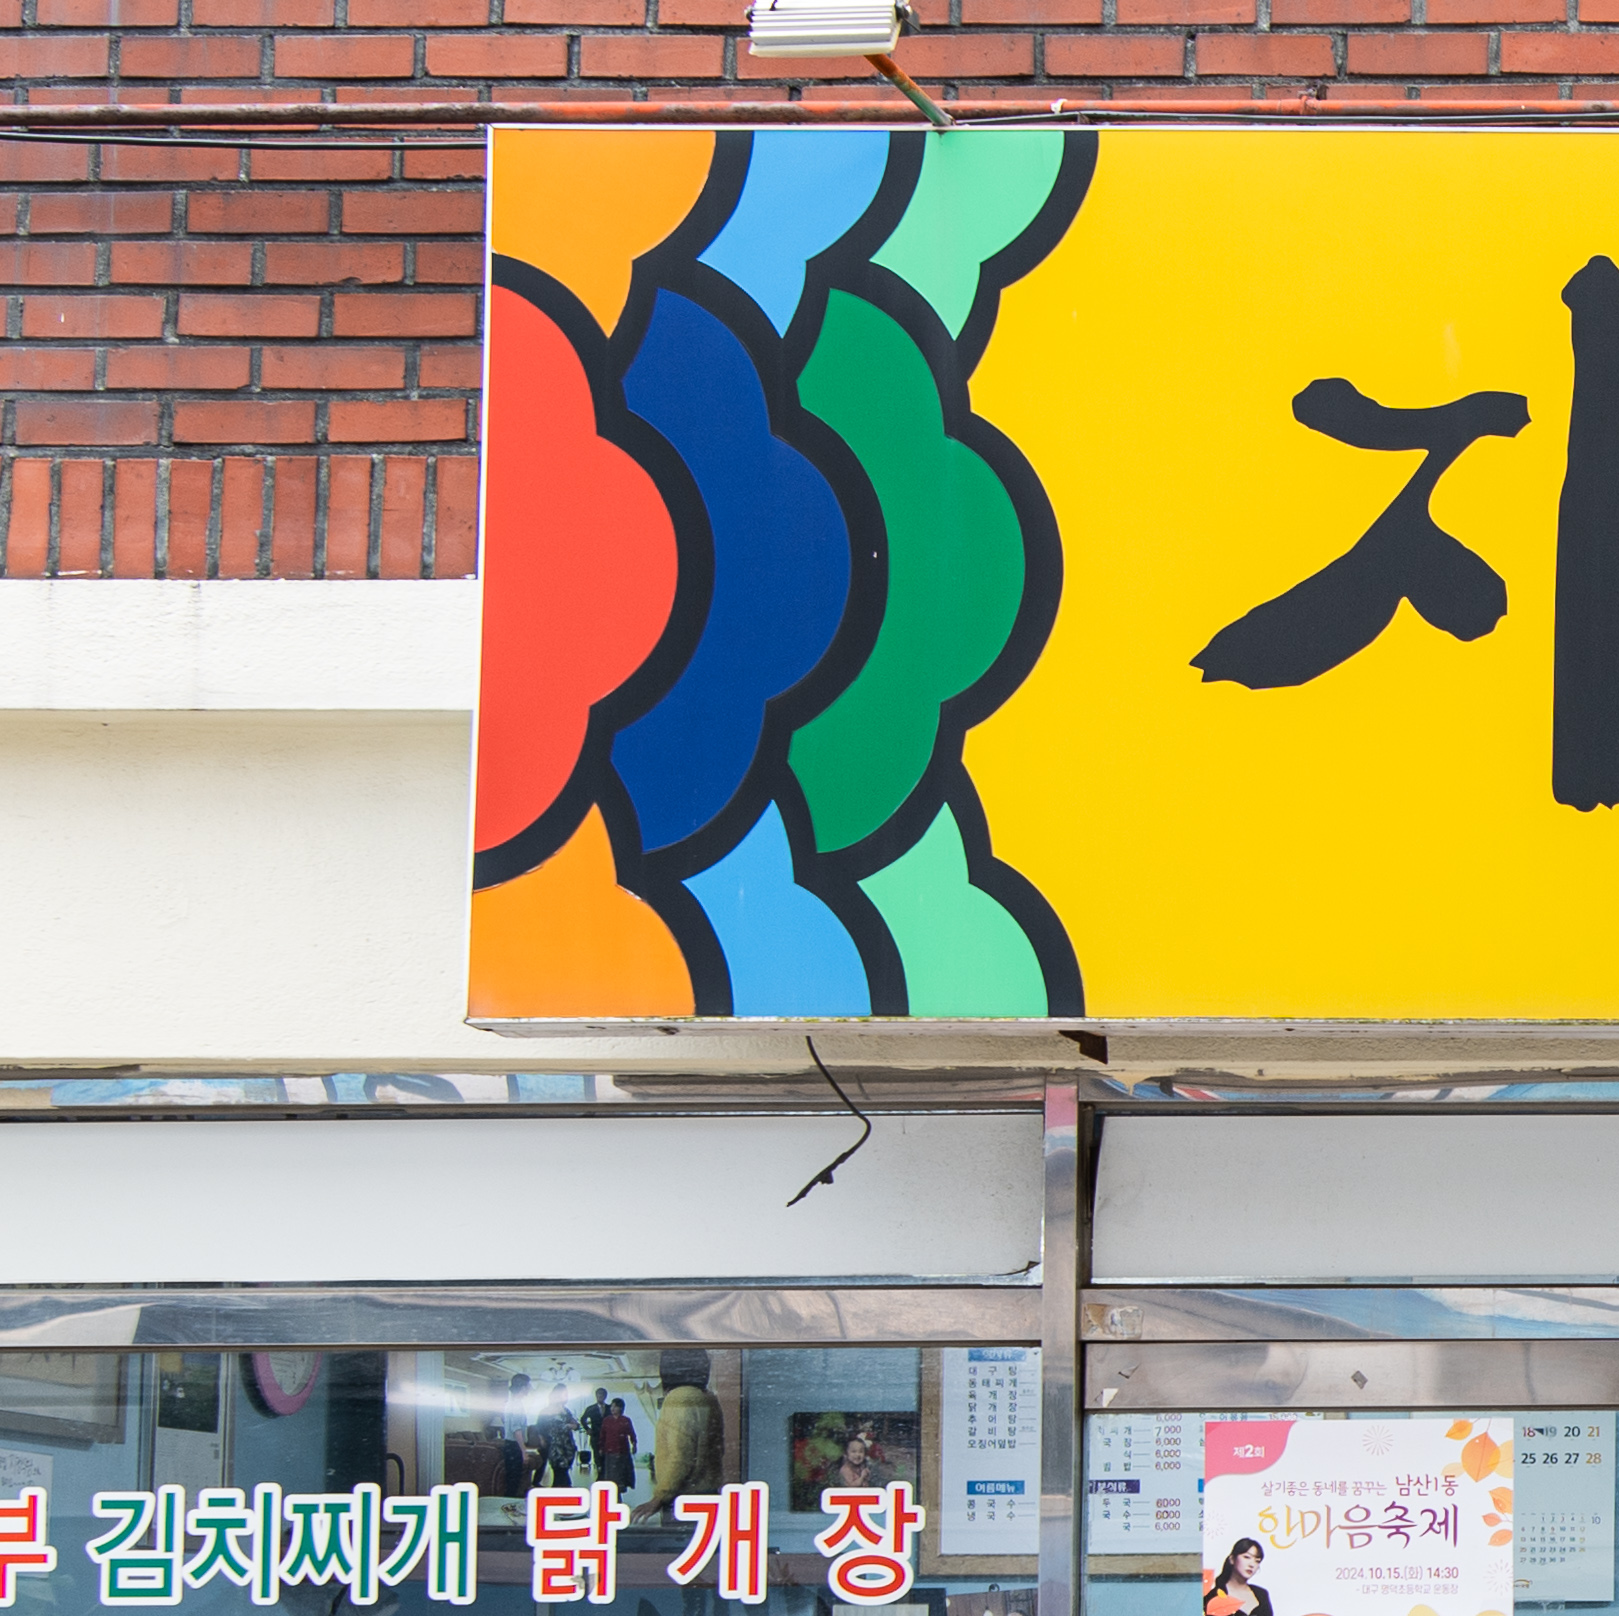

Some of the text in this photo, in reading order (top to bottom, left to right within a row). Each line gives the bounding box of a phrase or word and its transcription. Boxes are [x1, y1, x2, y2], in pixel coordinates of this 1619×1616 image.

[1564, 1426, 1581, 1437] 20
[1587, 1426, 1600, 1437] 21
[1233, 1444, 1265, 1458] 제2회
[1521, 1453, 1602, 1464] 25 26 27 28
[1261, 1474, 1459, 1497] 살기좋은 동네를 꿈꾸는 남산1동
[1258, 1501, 1459, 1549] 한마음축제
[94, 1489, 471, 1599] 김치찌개
[1427, 1567, 1459, 1580] 14:30
